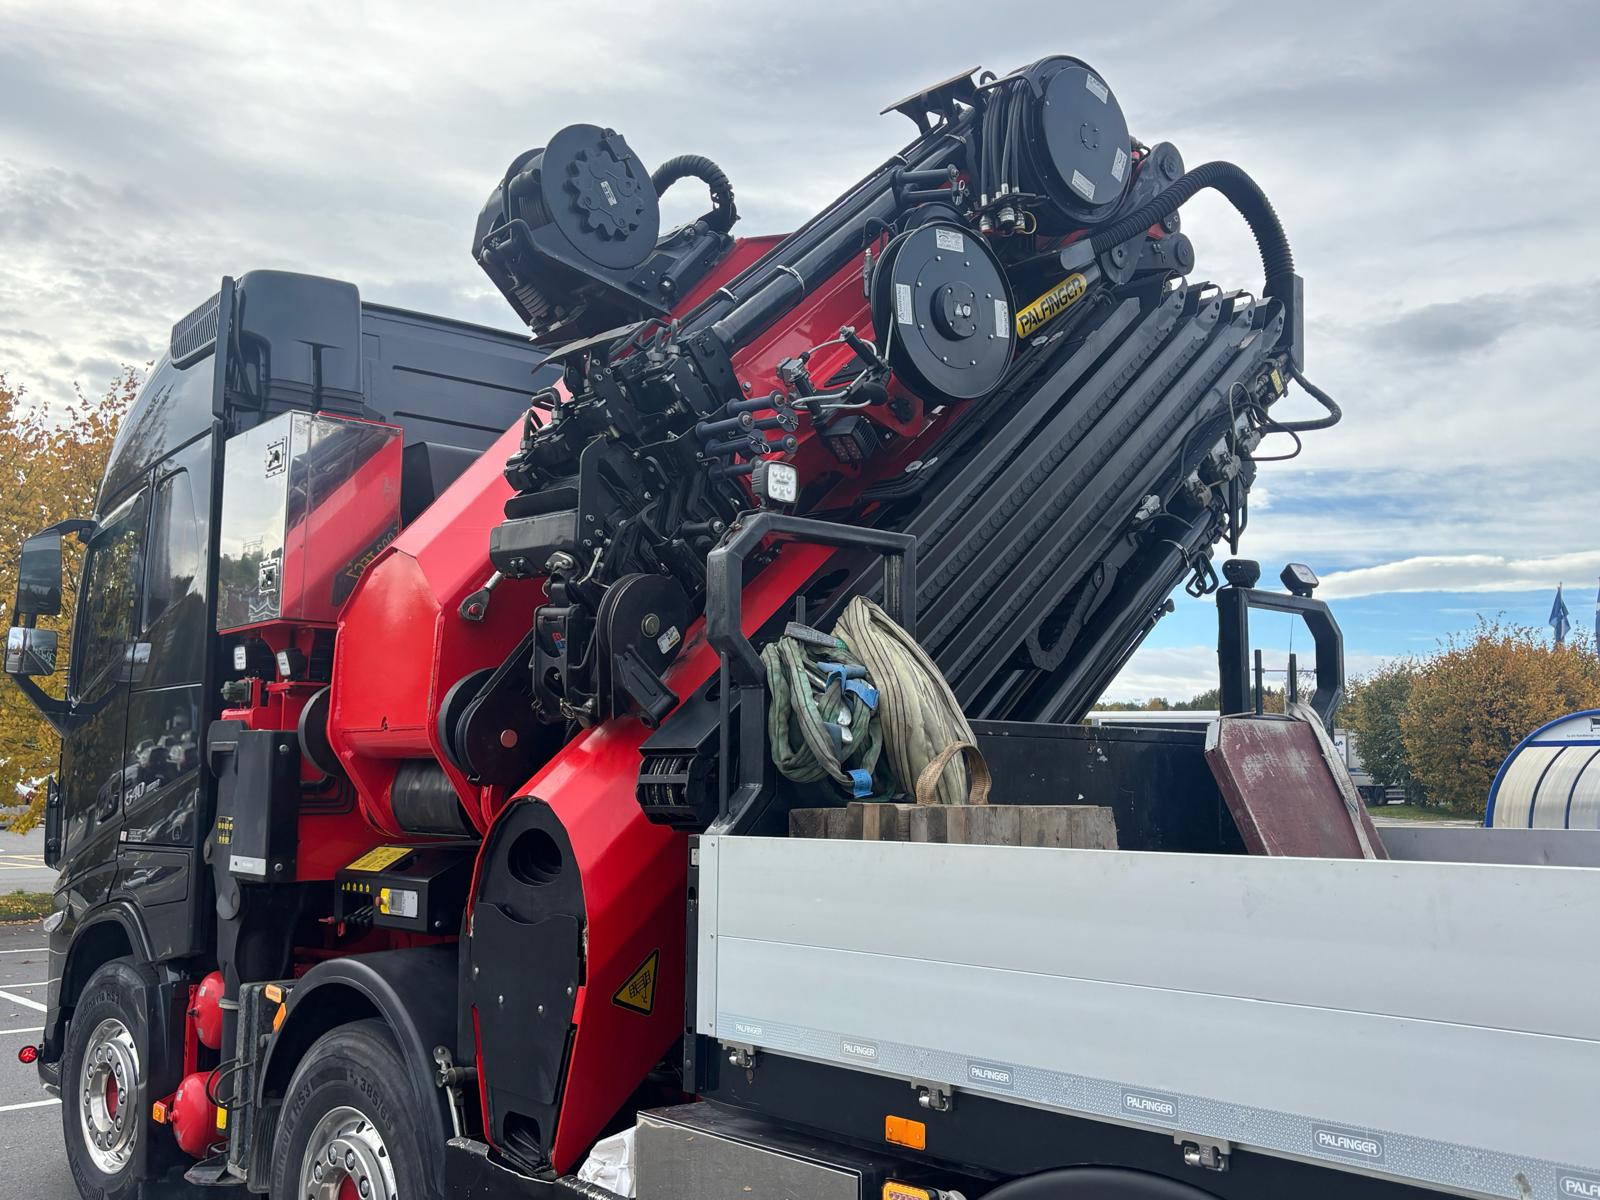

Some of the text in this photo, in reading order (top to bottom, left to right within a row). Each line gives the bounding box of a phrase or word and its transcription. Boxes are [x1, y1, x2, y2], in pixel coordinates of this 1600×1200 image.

[1018, 277, 1083, 334] PALFINGER
[736, 1023, 762, 1036] PALFINGER
[843, 1043, 876, 1057] PALFINGER
[971, 1067, 1010, 1083] PALFINGER
[1126, 1096, 1173, 1115] PALFINGER
[1319, 1133, 1377, 1154] PALFINGER
